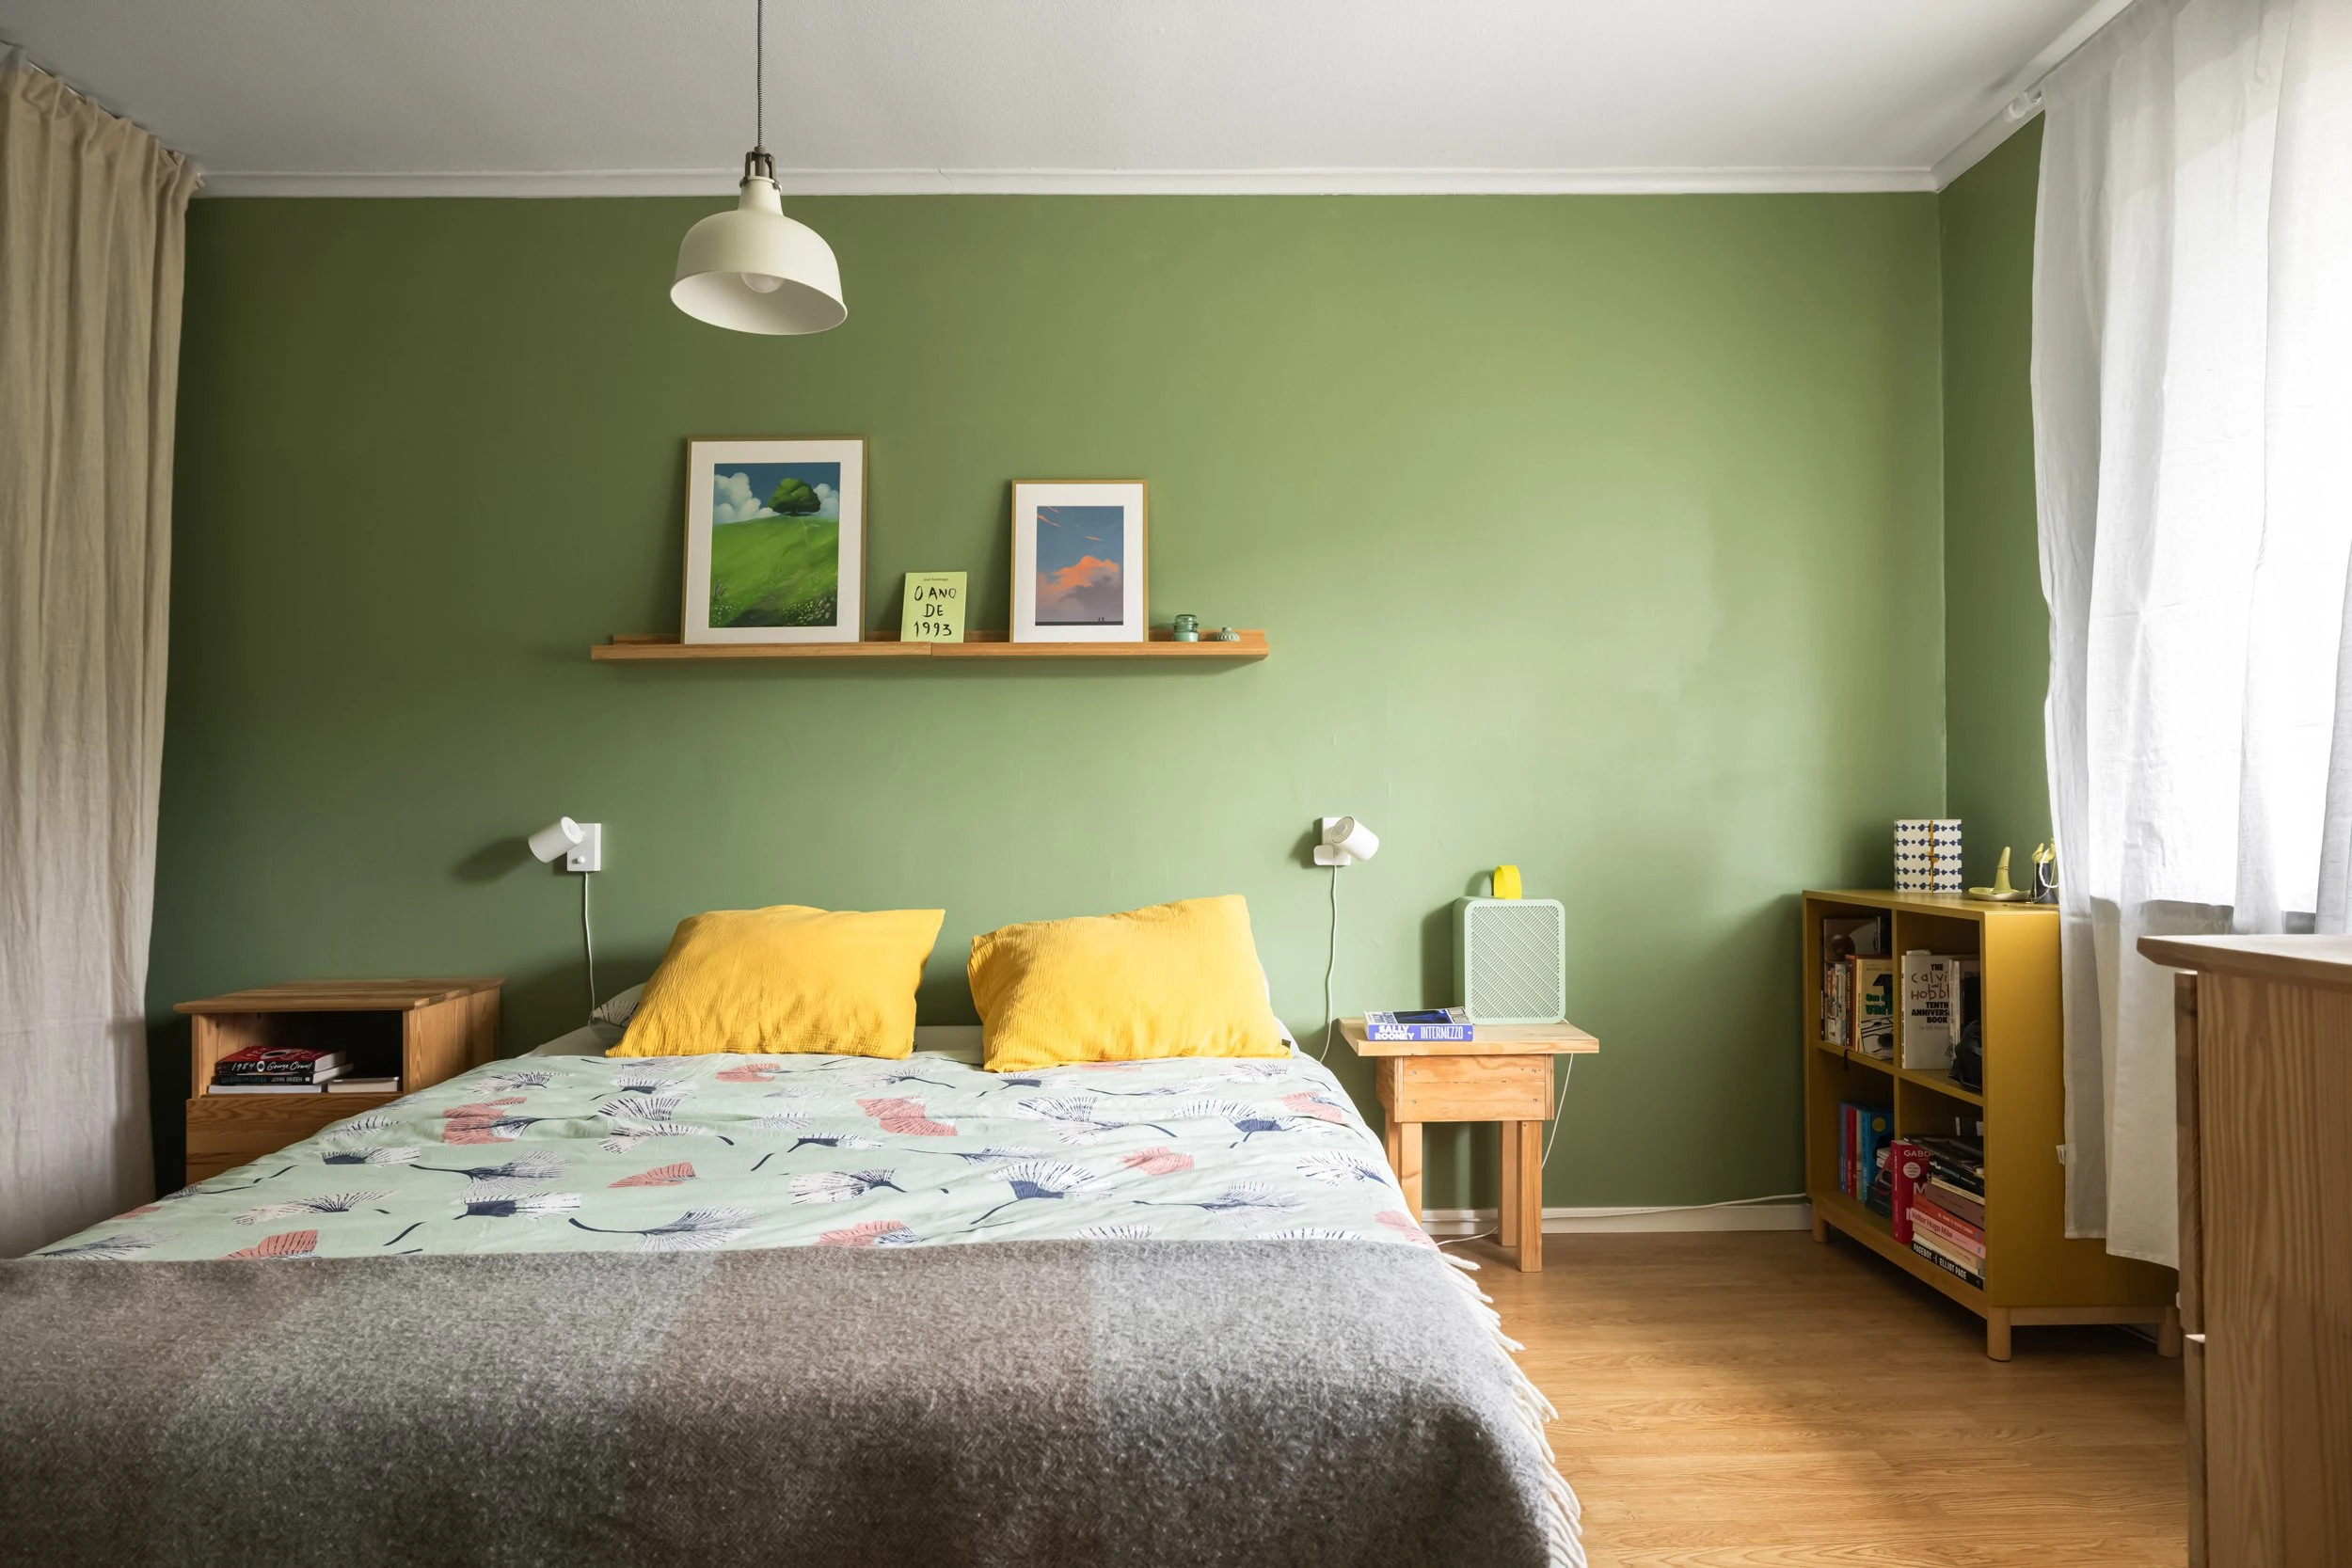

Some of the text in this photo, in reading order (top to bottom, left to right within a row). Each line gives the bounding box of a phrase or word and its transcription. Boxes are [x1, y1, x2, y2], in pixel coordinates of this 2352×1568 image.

[914, 585, 957, 601] O ANO
[923, 603, 944, 618] DE
[914, 621, 952, 638] 1993
[1911, 971, 1948, 984] Calvi
[1421, 1026, 1464, 1039] INTERMEZZO
[231, 1061, 313, 1071] 1984 George Orwell
[1939, 1257, 1955, 1273] ELLIOT
[1954, 1265, 1968, 1280] PAGE
